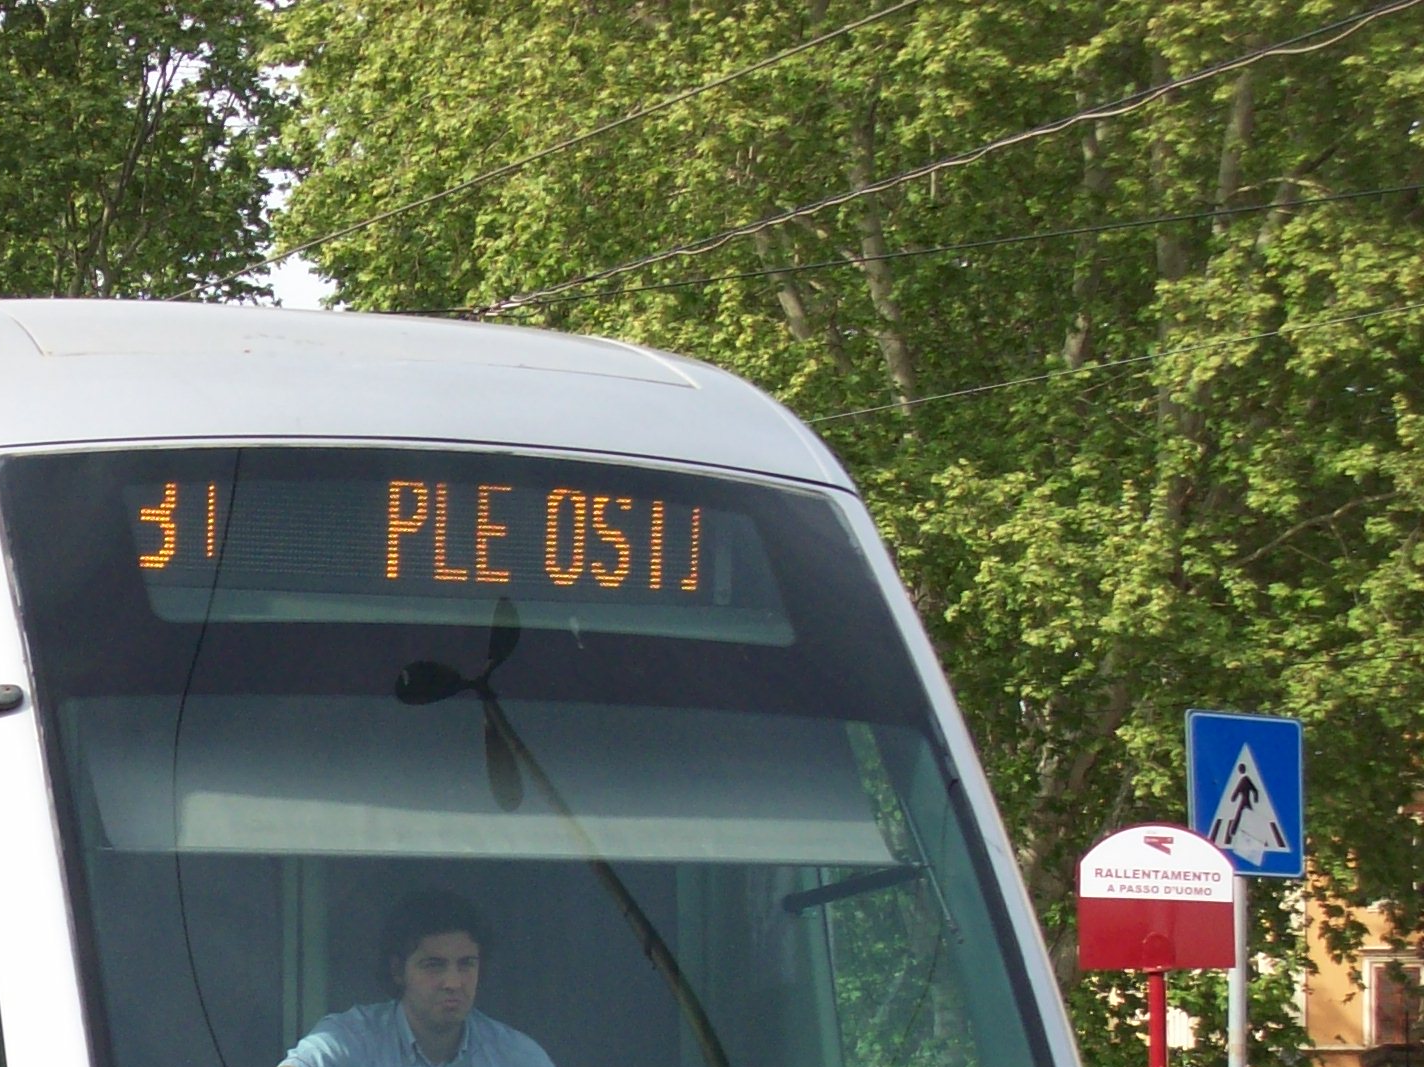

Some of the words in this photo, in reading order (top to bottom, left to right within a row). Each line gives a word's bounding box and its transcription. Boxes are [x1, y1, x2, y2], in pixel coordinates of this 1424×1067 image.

[386, 480, 513, 581] PLE
[1094, 867, 1222, 882] RALLENTAMENTO
[1106, 884, 1115, 893] A
[1119, 884, 1160, 894] PASSO
[1163, 886, 1213, 896] D'UOMO
